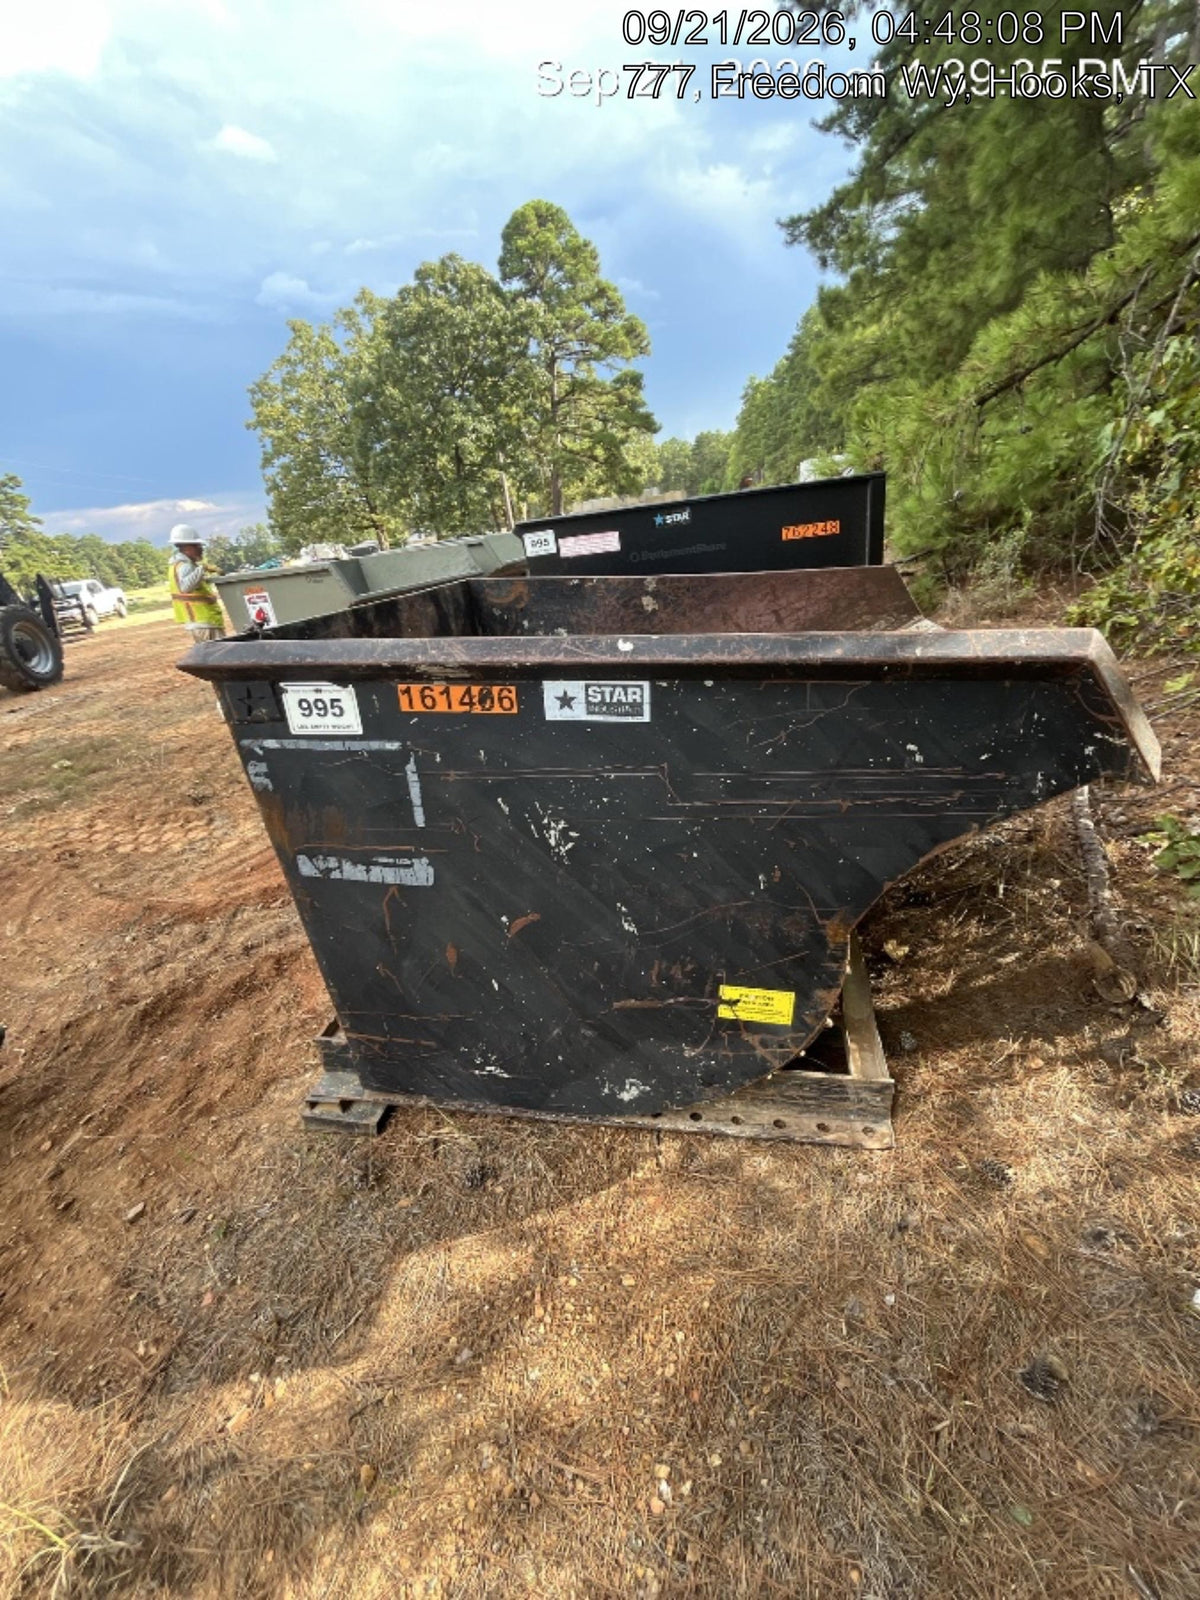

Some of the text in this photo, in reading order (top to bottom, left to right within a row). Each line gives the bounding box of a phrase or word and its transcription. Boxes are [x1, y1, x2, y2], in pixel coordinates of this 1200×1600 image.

[665, 511, 690, 523] STAR
[399, 685, 515, 712] 161406
[588, 685, 642, 703] STAR
[297, 697, 345, 717] 995
